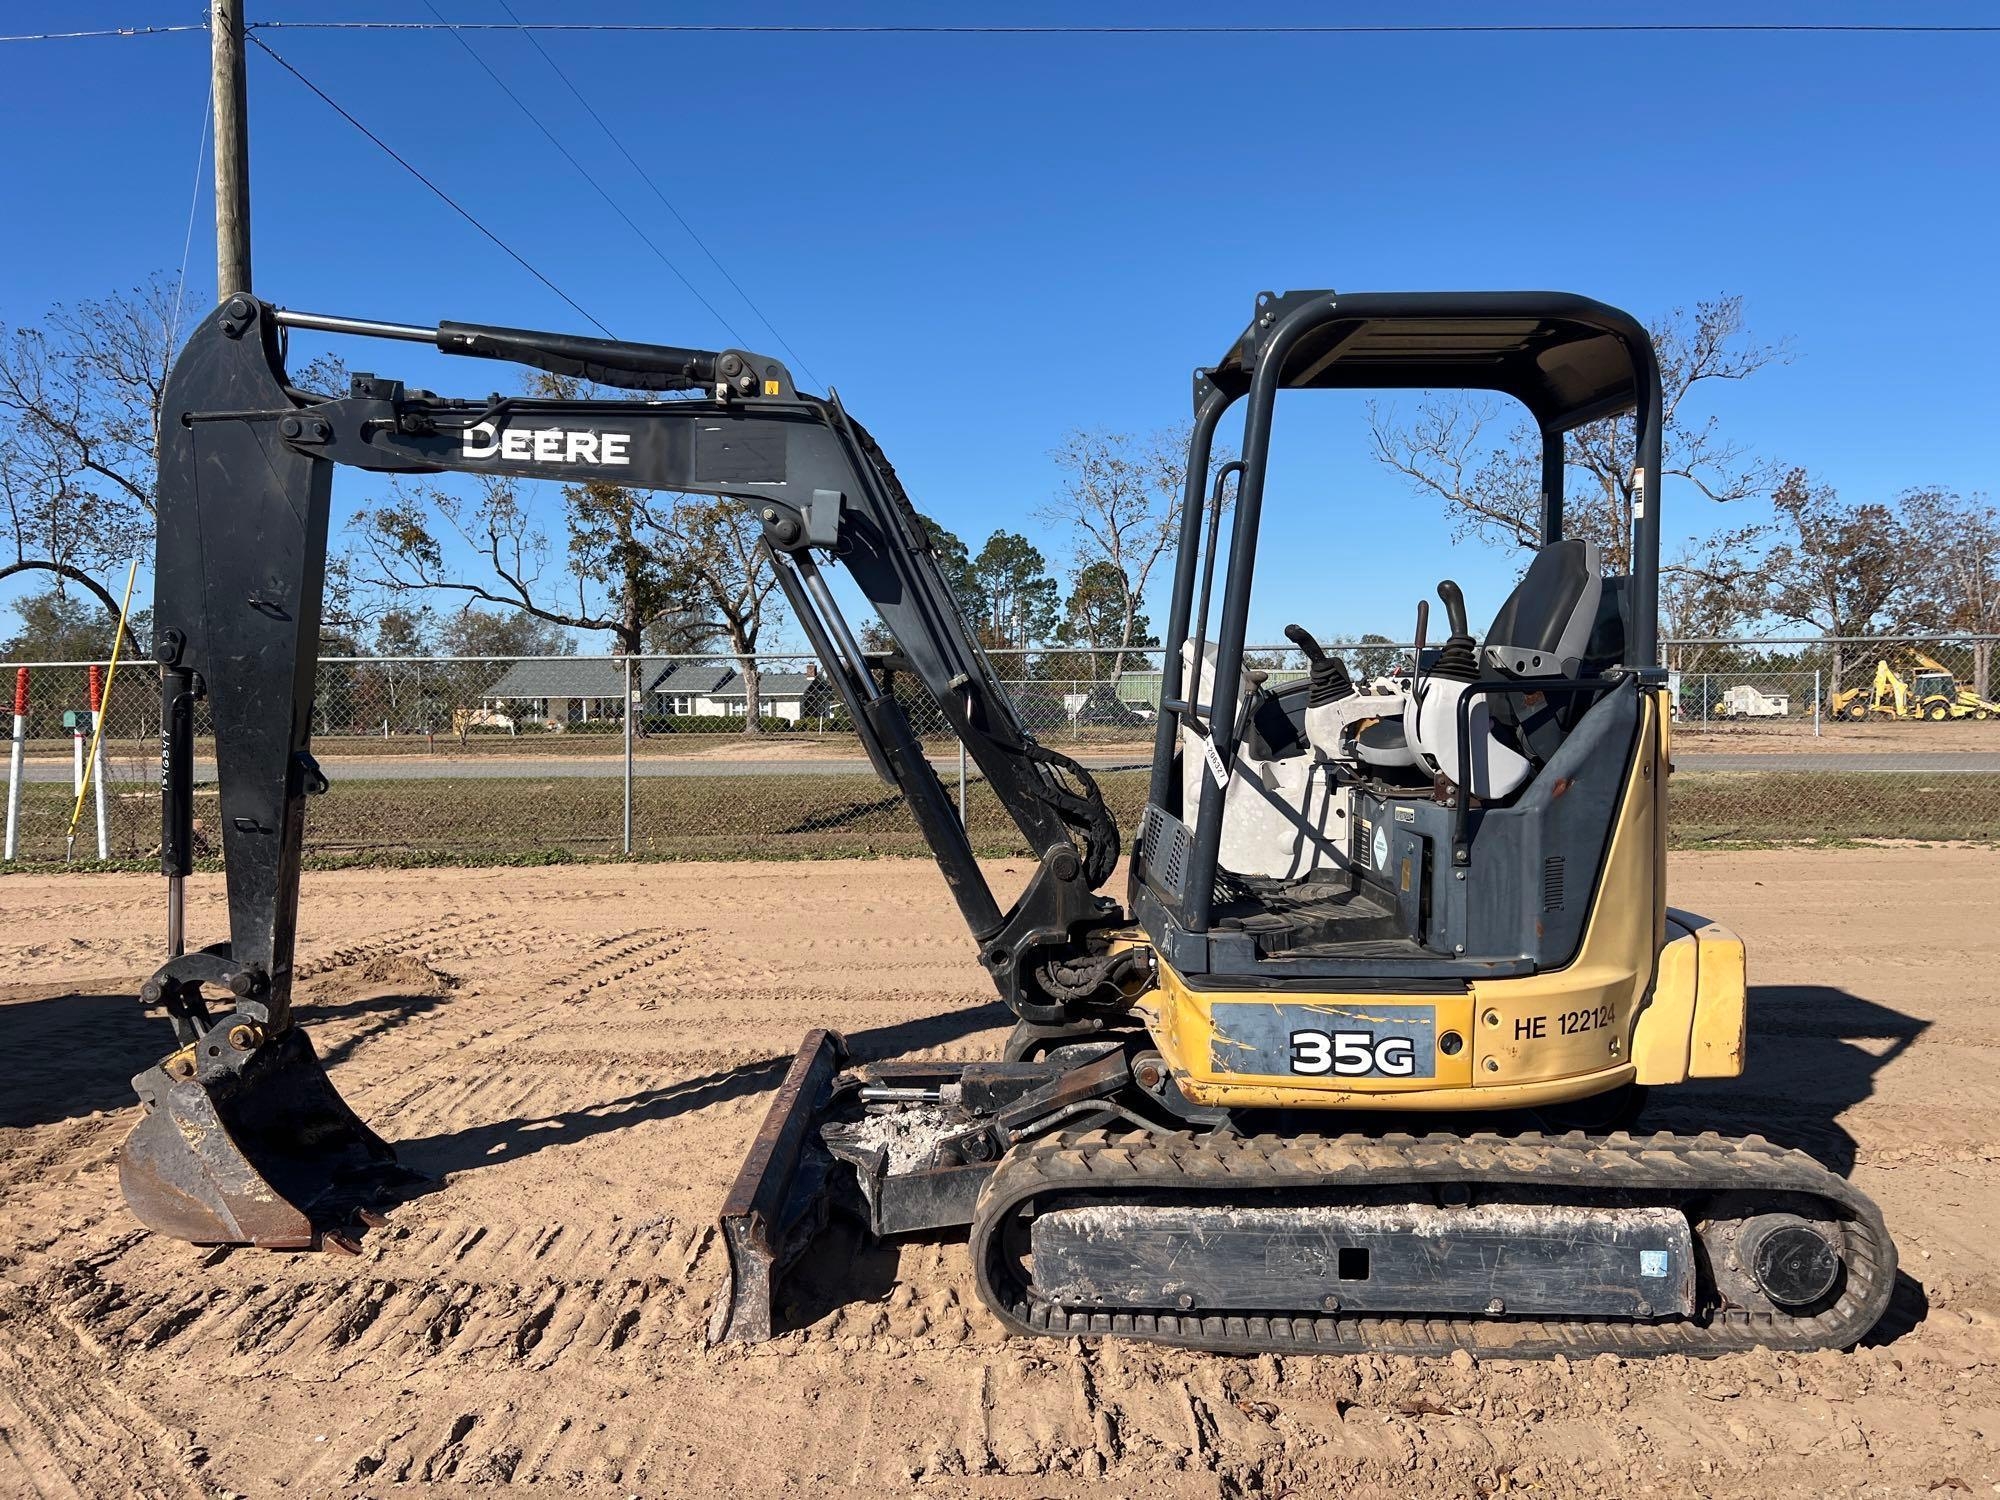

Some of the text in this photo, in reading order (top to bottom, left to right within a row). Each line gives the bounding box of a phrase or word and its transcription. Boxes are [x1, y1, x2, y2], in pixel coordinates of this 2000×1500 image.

[462, 420, 631, 465] DEERE
[1514, 1002, 1615, 1040] HE 122124
[1290, 1029, 1415, 1077] 35G
